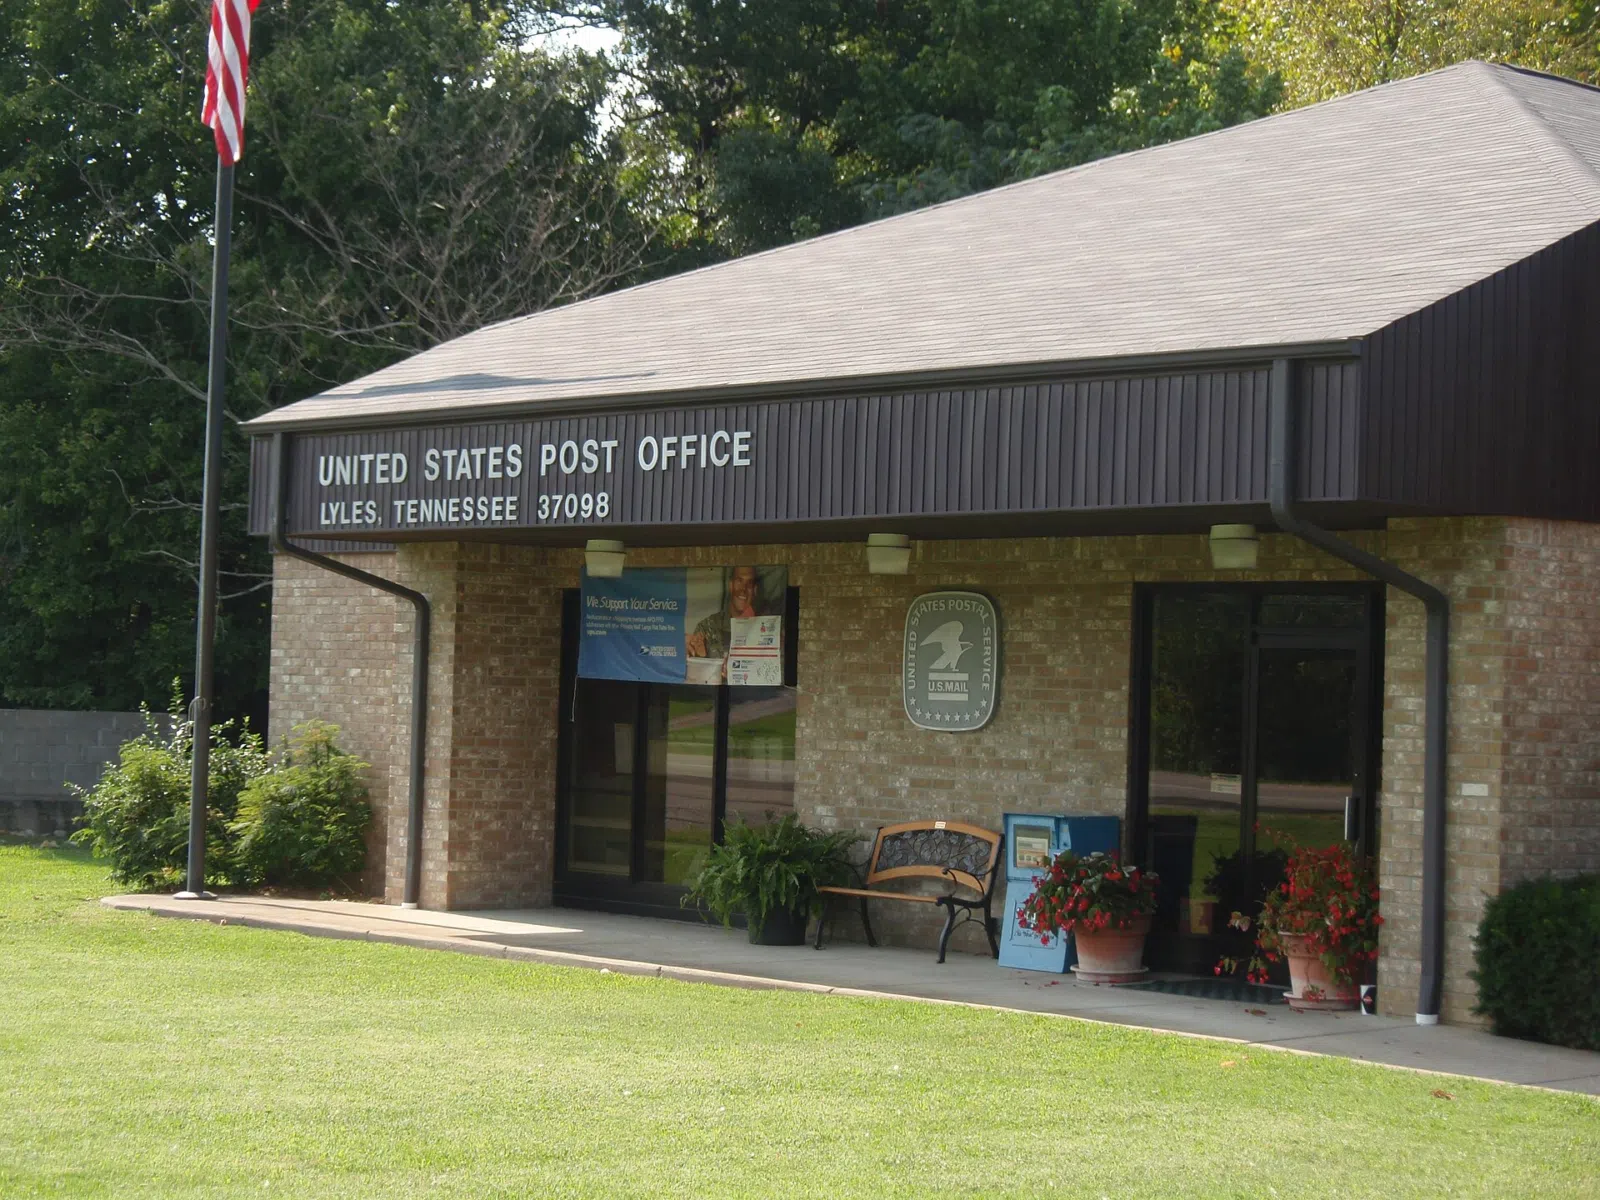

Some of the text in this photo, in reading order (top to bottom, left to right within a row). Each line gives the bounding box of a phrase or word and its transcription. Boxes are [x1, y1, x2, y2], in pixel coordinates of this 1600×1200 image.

[319, 430, 752, 487] UNITED STATES POST OFFICE
[320, 492, 610, 526] LYLES, TENNESSEE 37098
[586, 595, 679, 612] We Support Your Service.
[908, 599, 992, 691] UNITED STATES POSTAL SERVICE
